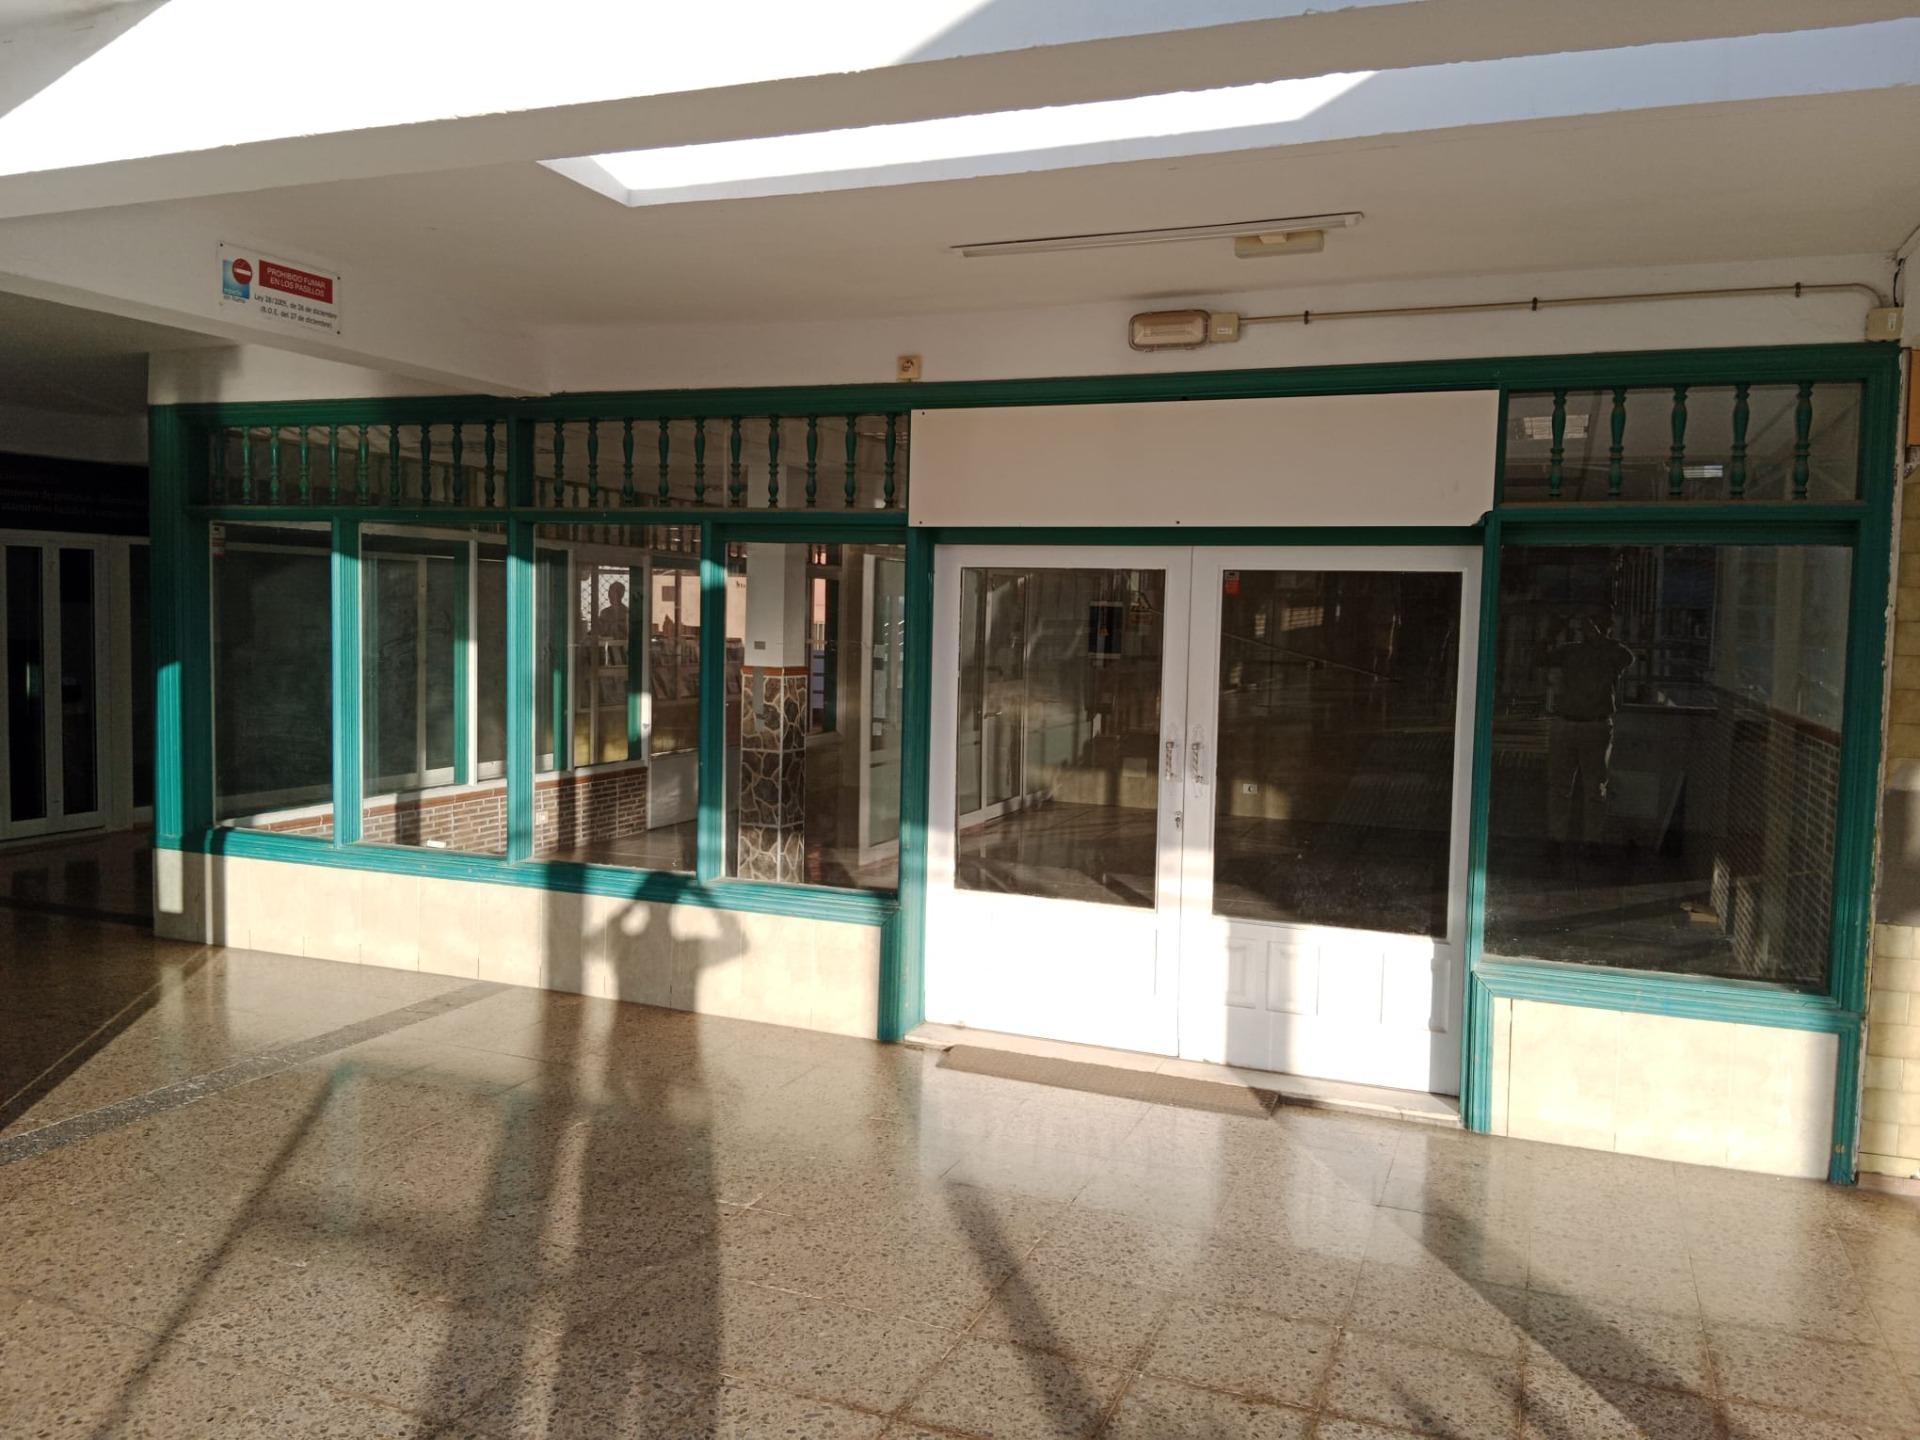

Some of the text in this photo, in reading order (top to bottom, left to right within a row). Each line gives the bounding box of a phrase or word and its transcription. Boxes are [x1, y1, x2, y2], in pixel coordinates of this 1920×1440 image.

[267, 267, 327, 289] PROHIBIDO FUMAR
[270, 277, 325, 297] EN LOS PASILLOS
[254, 293, 264, 302] Ley
[313, 308, 337, 319] diciembre
